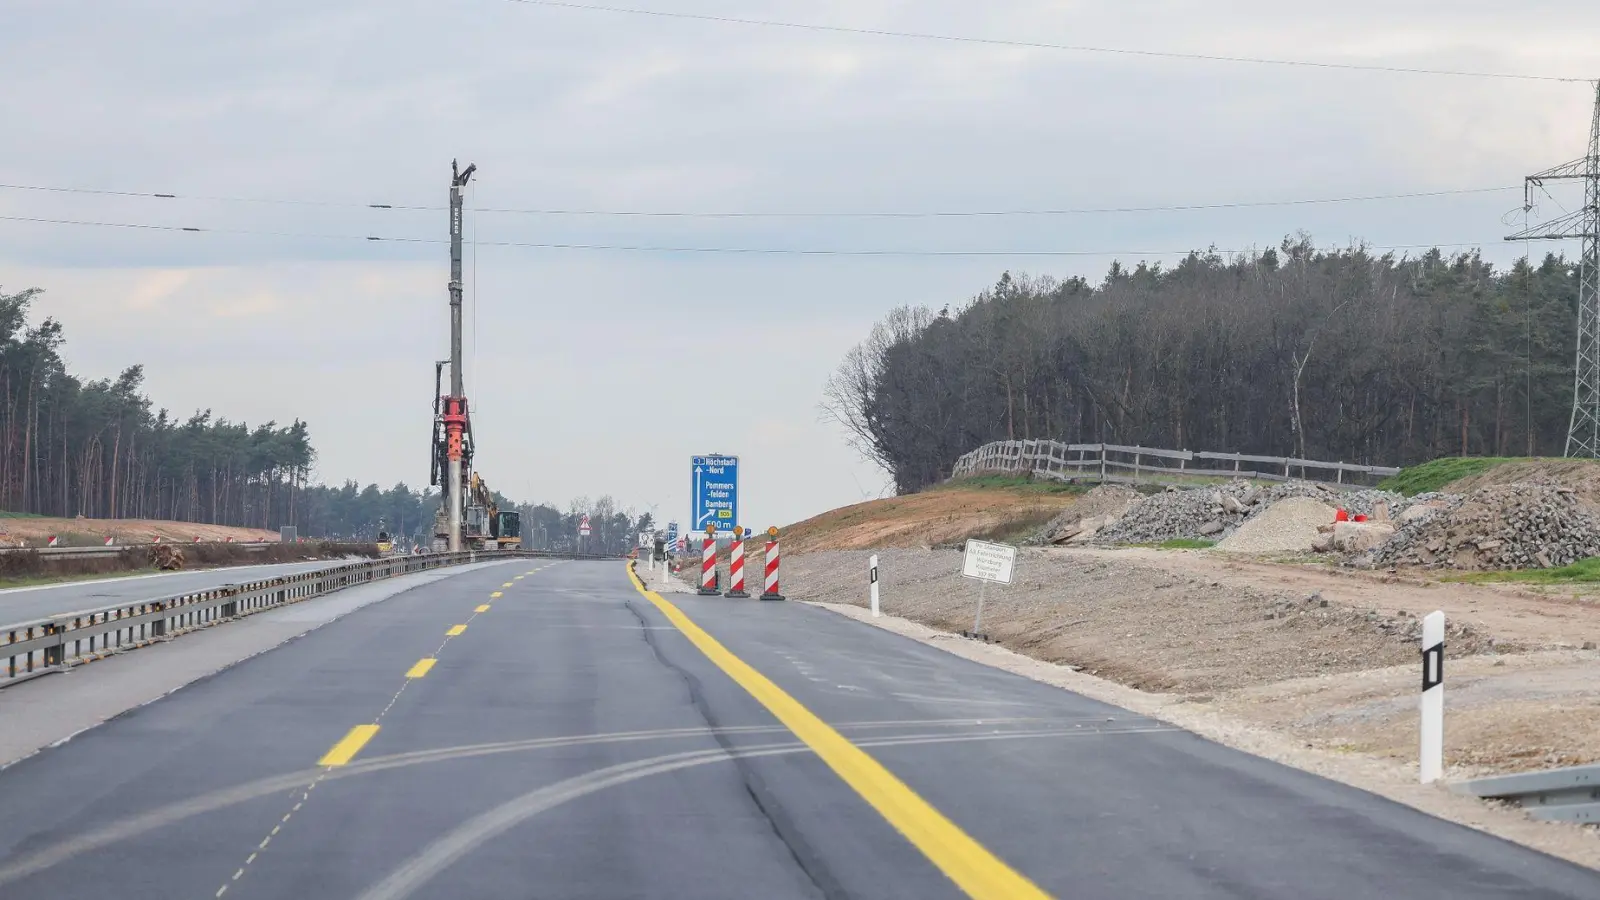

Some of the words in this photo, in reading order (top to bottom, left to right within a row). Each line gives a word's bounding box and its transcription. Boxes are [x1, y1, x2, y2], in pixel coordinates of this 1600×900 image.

[705, 457, 736, 466] Höchstadt
[706, 466, 724, 474] -Nord
[705, 481, 734, 489] Pommers
[707, 490, 729, 498] -felden
[705, 500, 733, 510] Bamberg
